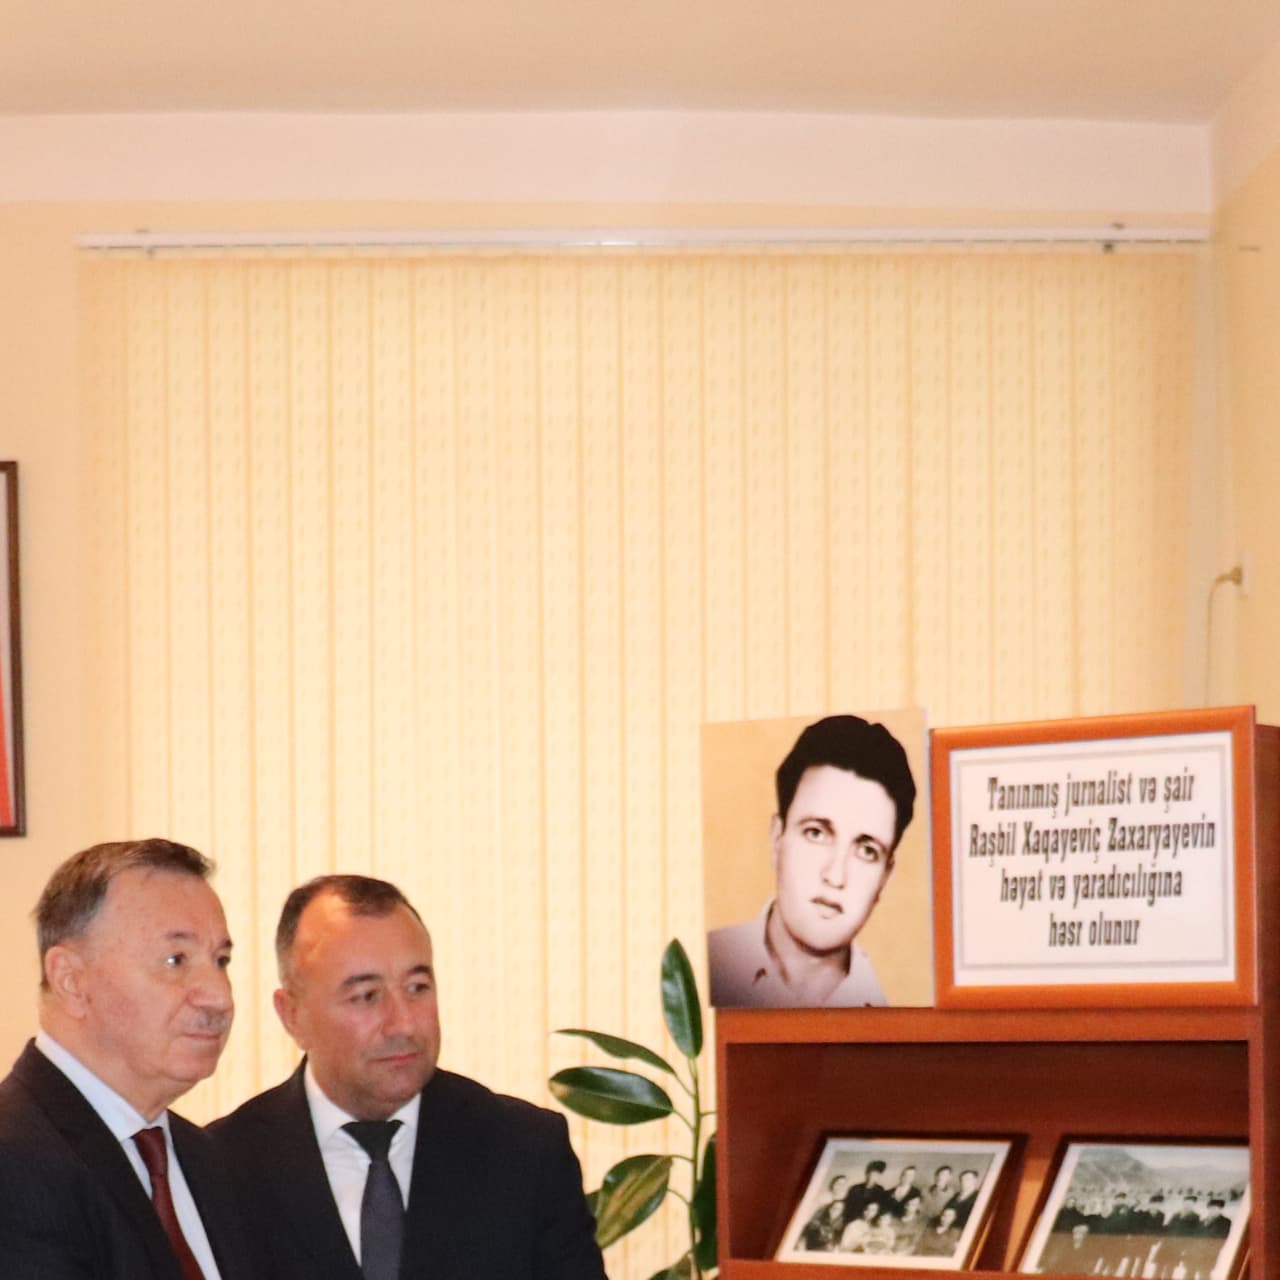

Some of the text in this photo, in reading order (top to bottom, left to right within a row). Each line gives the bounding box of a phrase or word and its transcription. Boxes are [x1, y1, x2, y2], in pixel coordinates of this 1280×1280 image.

[988, 766, 1195, 819] Tanınmış jurnalist və şair
[969, 812, 1216, 868] Raşbil Xaqayeviç Zaxaryayevin
[1000, 862, 1183, 911] həyat və yaradıcılığına
[1048, 911, 1141, 947] həsr olunur
